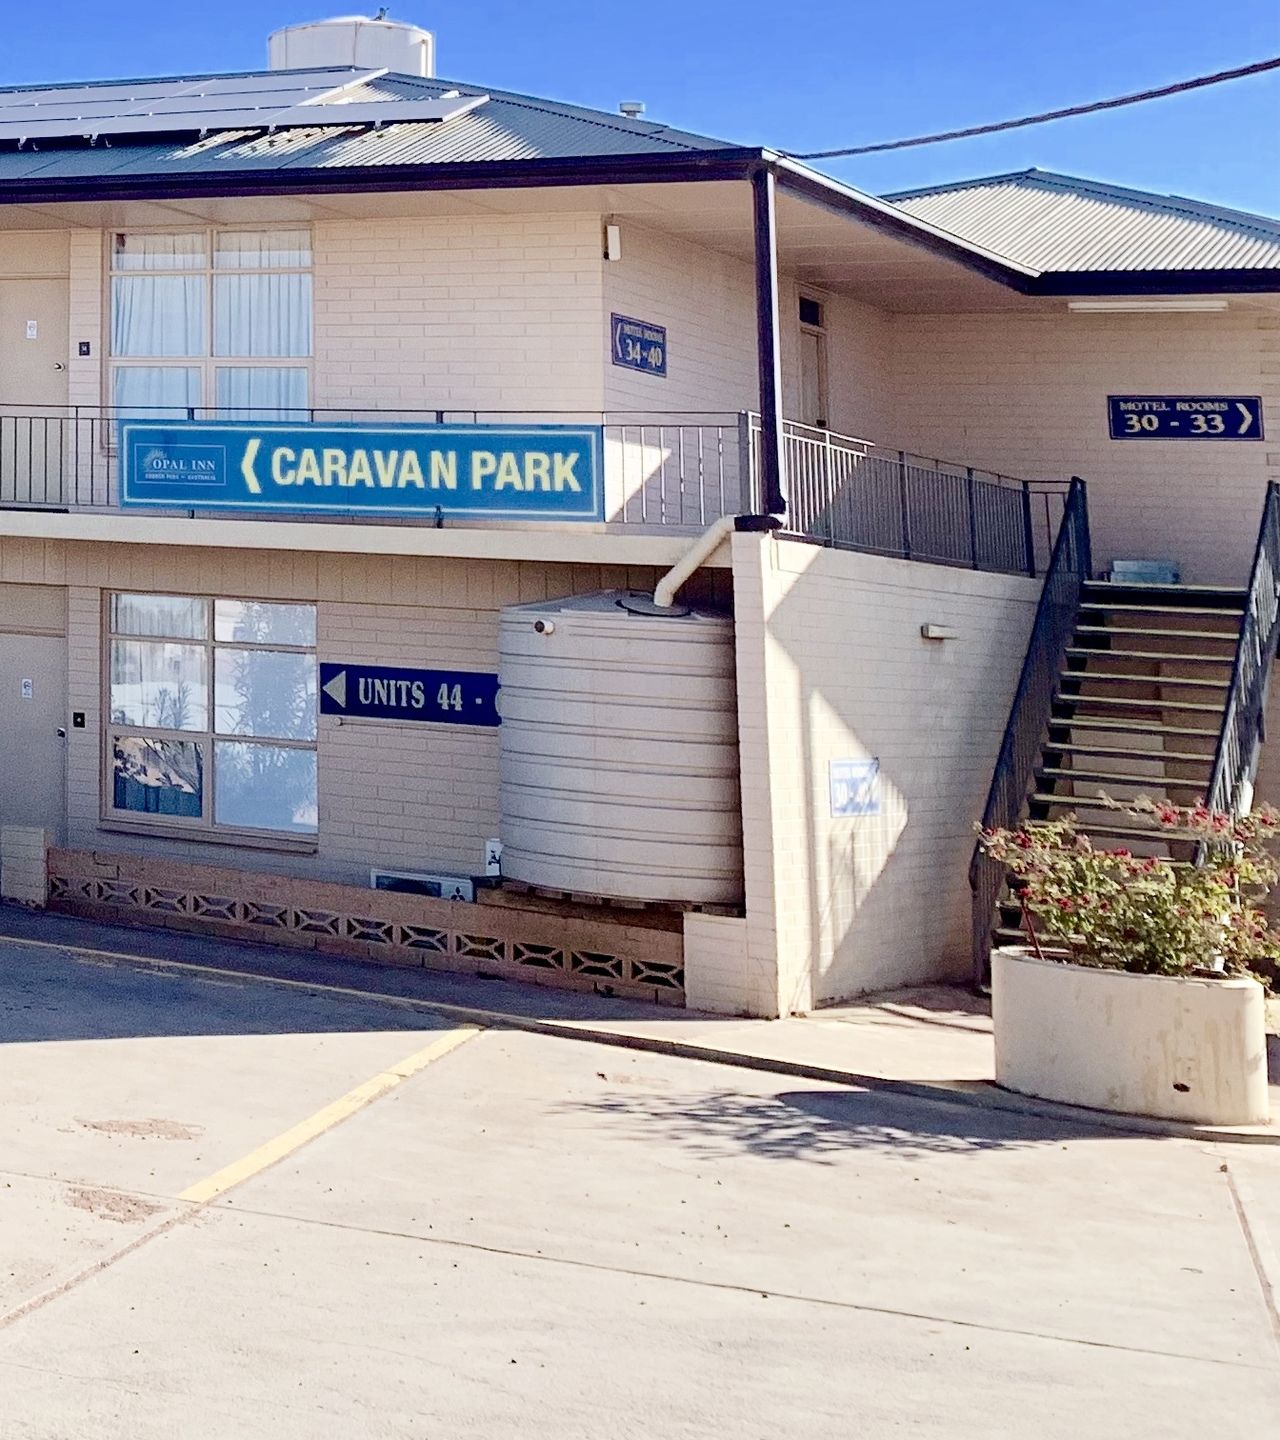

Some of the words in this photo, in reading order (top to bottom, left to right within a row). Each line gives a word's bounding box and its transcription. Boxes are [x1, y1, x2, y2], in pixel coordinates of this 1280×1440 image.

[1119, 401, 1171, 411] MOTEL
[1176, 401, 1229, 411] ROOMS
[1124, 413, 1159, 433] 30
[1190, 414, 1226, 434] 33
[152, 459, 187, 470] OPAL
[192, 460, 216, 471] INN
[271, 447, 458, 491] CARAVAN
[471, 450, 582, 493] PARK
[358, 677, 425, 709] UNITS
[437, 683, 463, 711] 44
